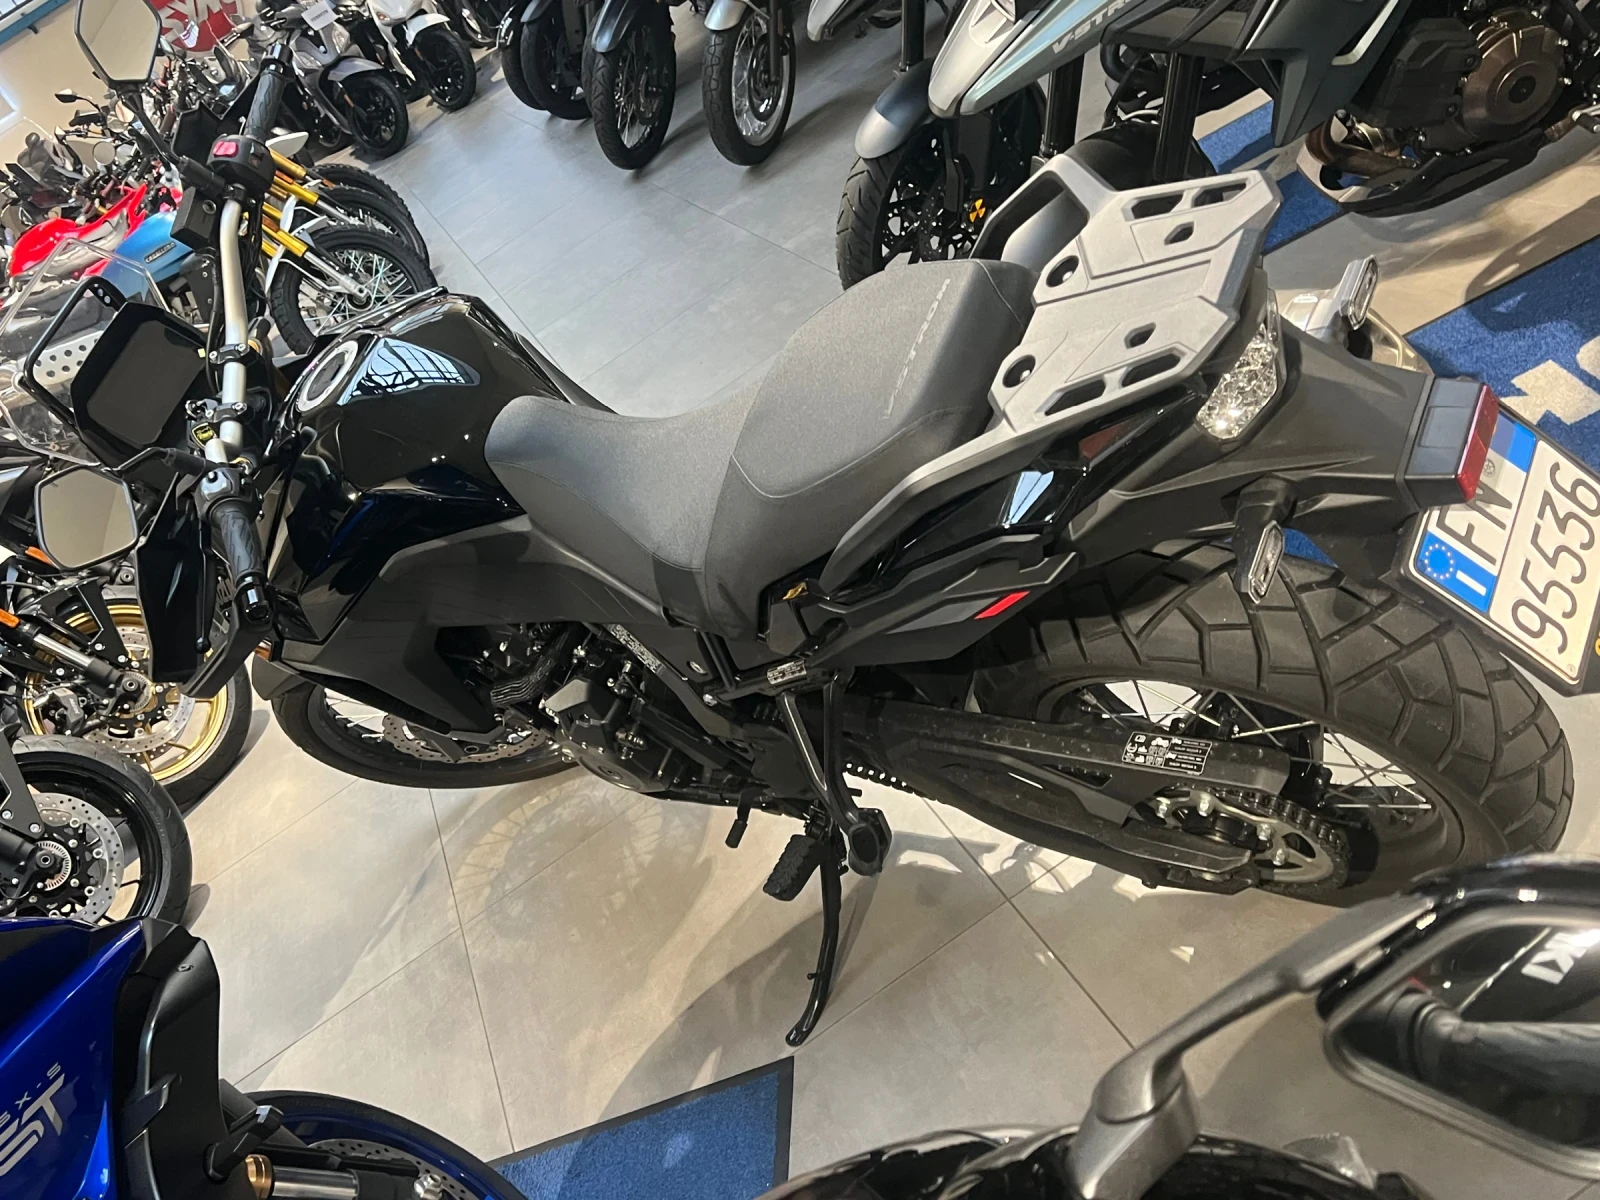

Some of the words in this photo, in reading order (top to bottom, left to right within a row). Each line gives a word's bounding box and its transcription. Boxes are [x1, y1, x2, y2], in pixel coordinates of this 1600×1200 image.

[1052, 0, 1132, 54] V-STR
[883, 278, 951, 419] V-STROM
[1435, 479, 1513, 566] FN
[1511, 461, 1600, 656] 95536
